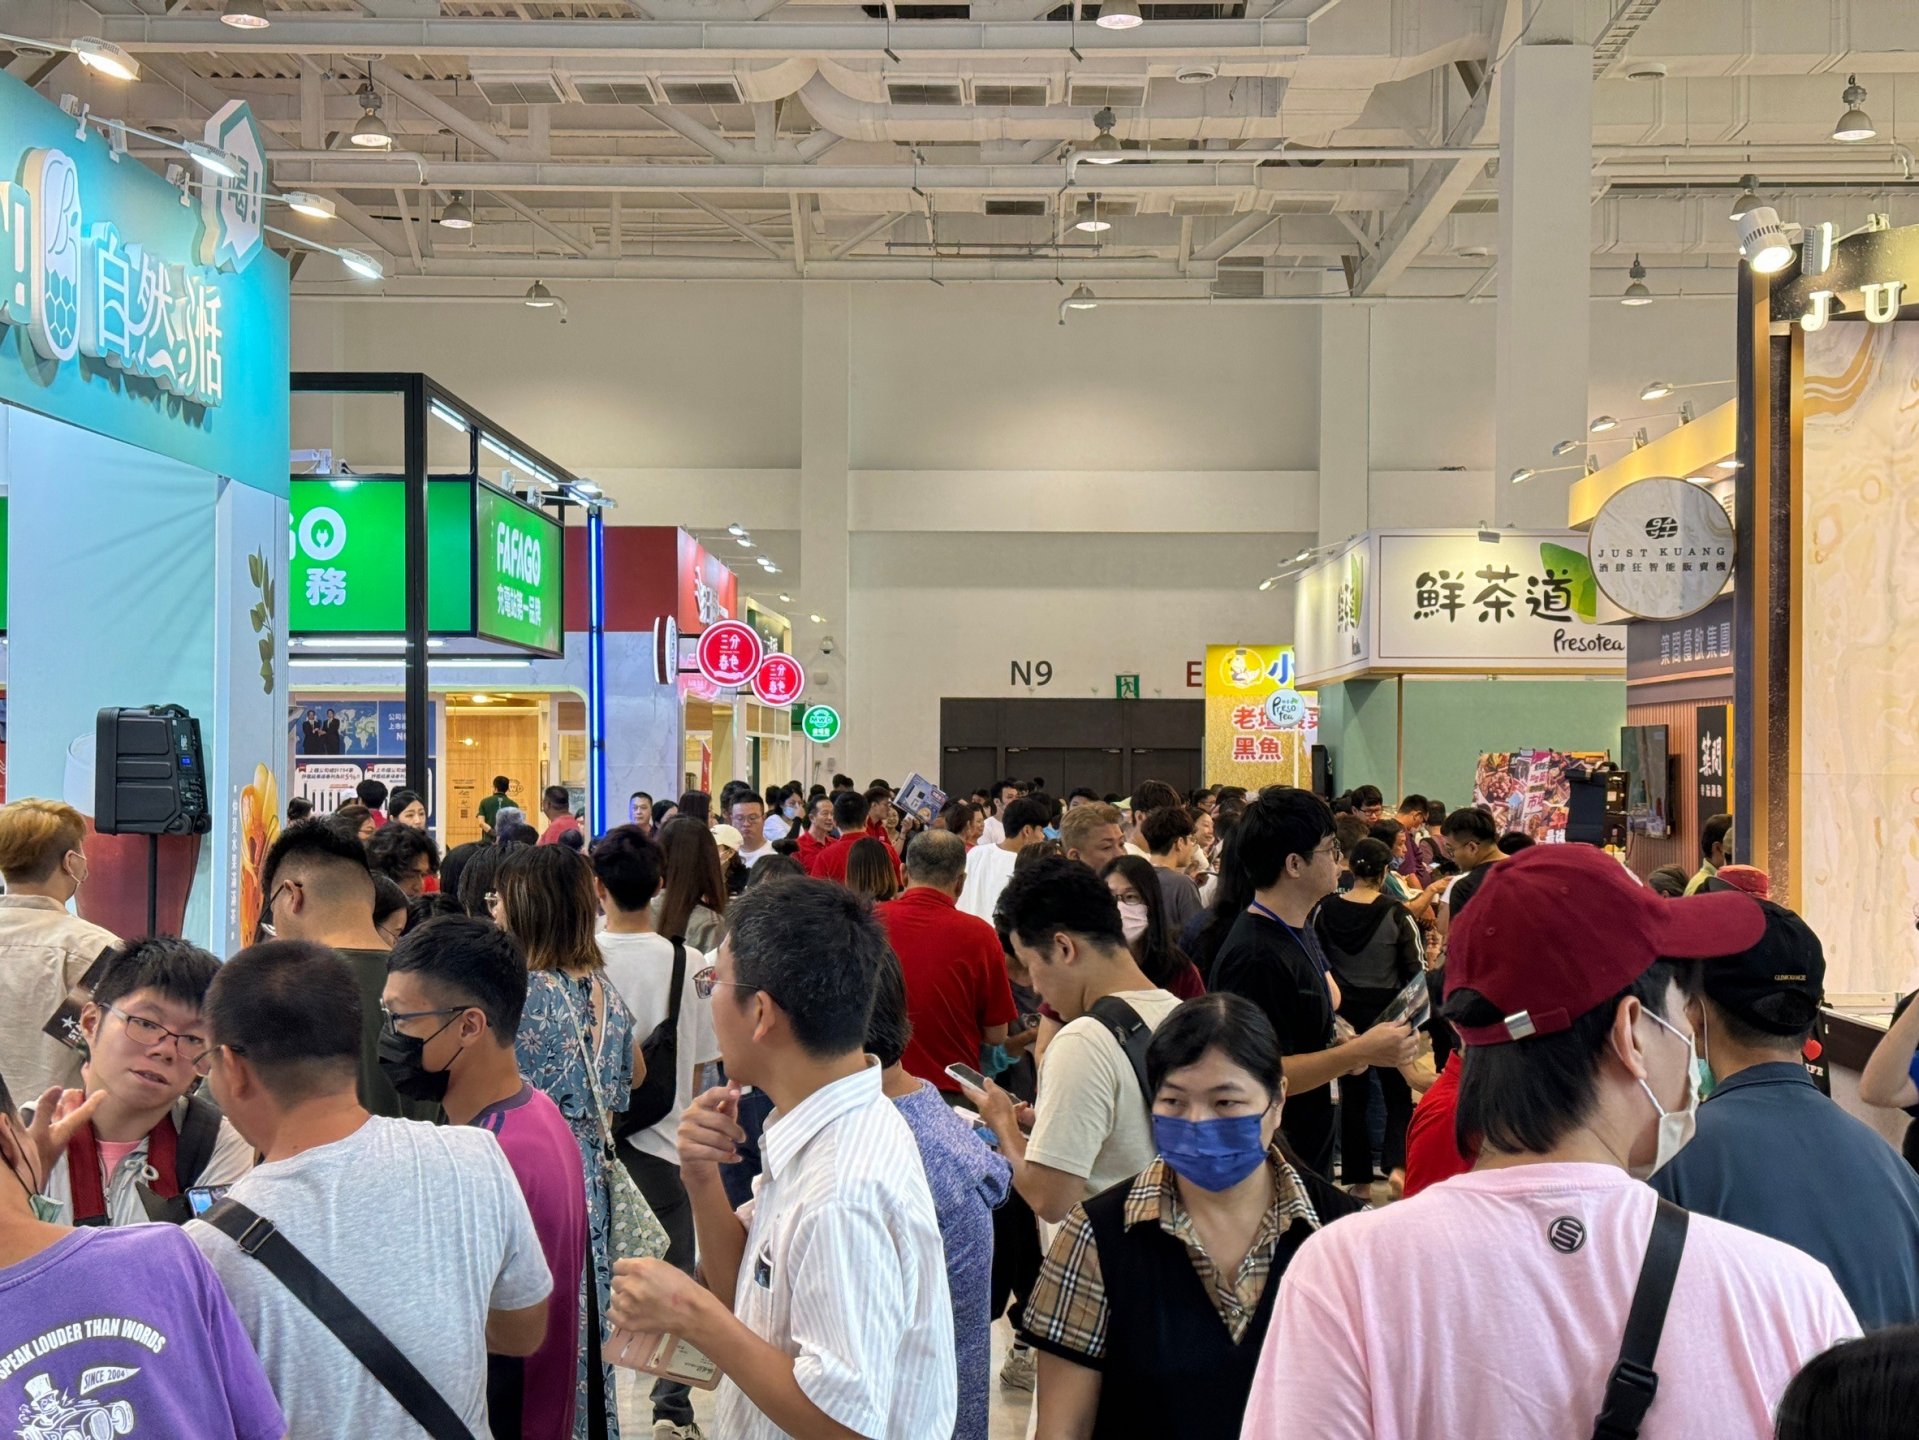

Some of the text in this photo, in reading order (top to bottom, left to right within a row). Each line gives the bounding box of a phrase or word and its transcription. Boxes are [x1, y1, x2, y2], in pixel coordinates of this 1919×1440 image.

[497, 521, 541, 587] FAFAGO
[1598, 547, 1726, 558] JUST KUANG
[305, 567, 347, 606] 務
[1414, 563, 1573, 623] 鮮茶道
[1553, 628, 1625, 653] Presotea
[1010, 660, 1053, 687] N9
[1234, 737, 1281, 760] 黑魚
[0, 1318, 166, 1380] SPEAK LOUDER THAN WORDS
[84, 1369, 126, 1390] SINCE 2004
